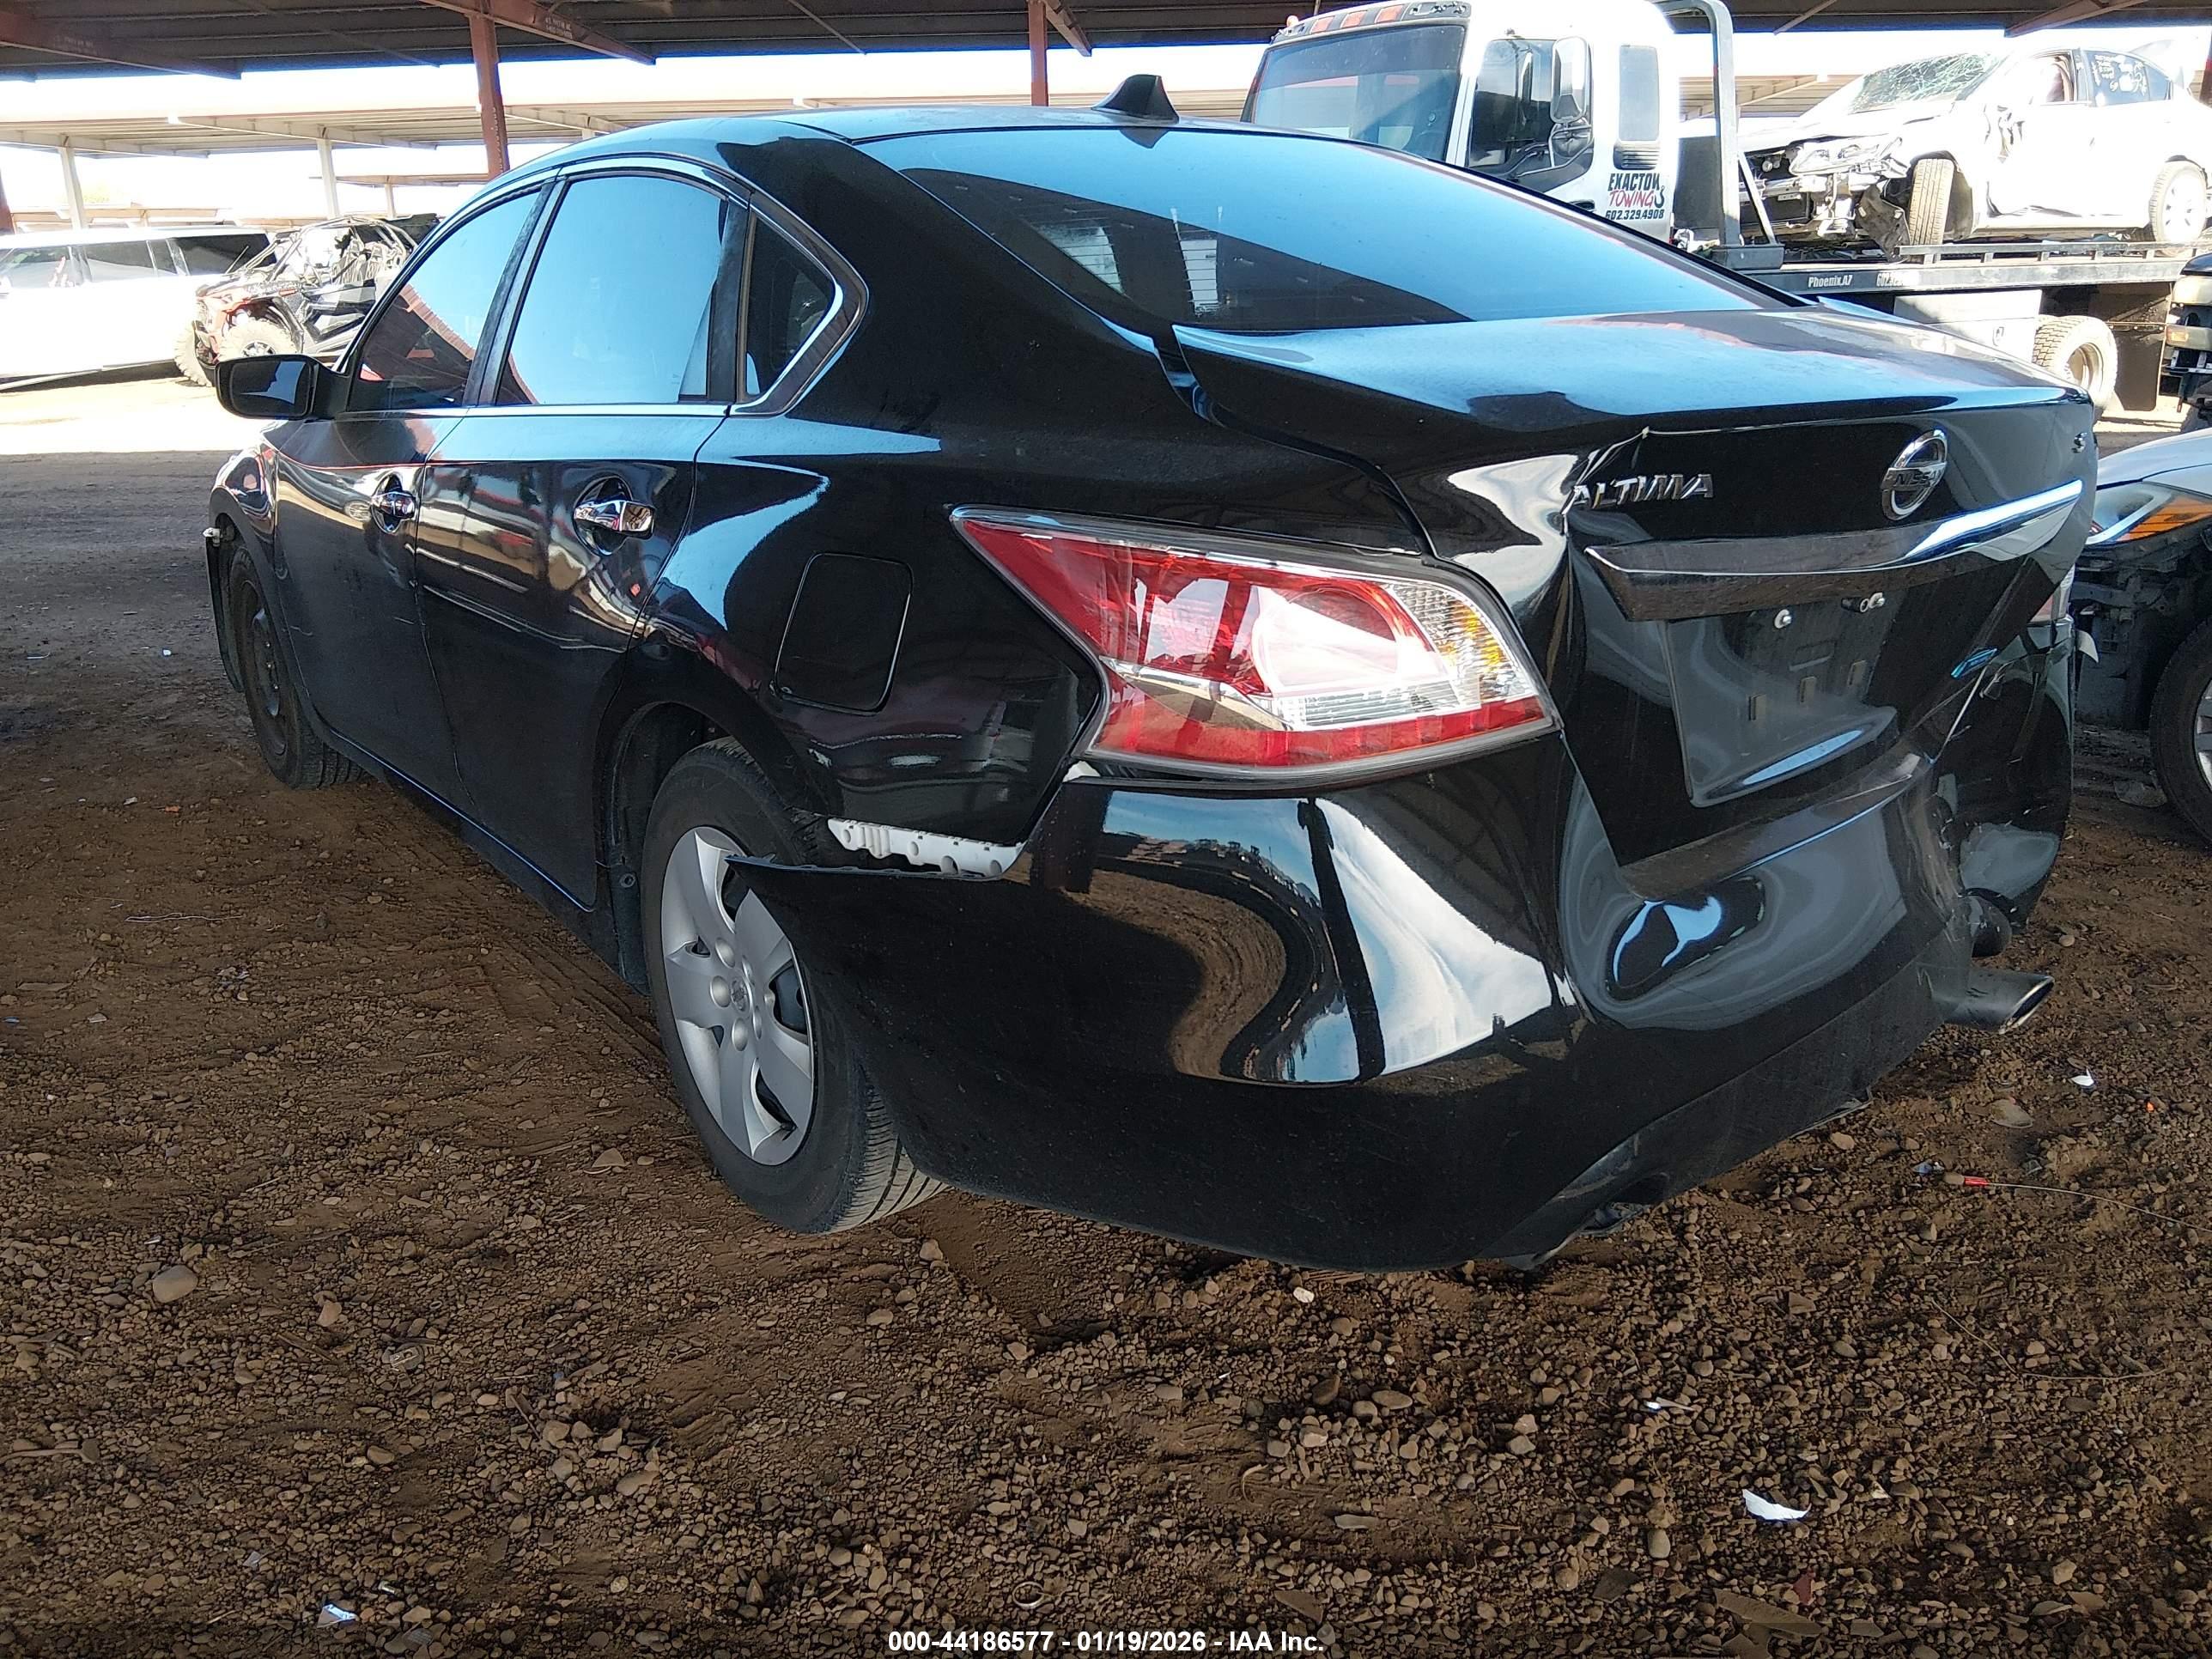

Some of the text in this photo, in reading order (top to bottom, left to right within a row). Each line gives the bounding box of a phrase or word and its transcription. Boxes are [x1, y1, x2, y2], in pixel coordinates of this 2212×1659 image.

[1609, 190, 1655, 209] TOWING
[2071, 432, 2087, 453] S
[1894, 466, 1943, 487] NISSAN
[1562, 473, 1714, 514] ALTIMA
